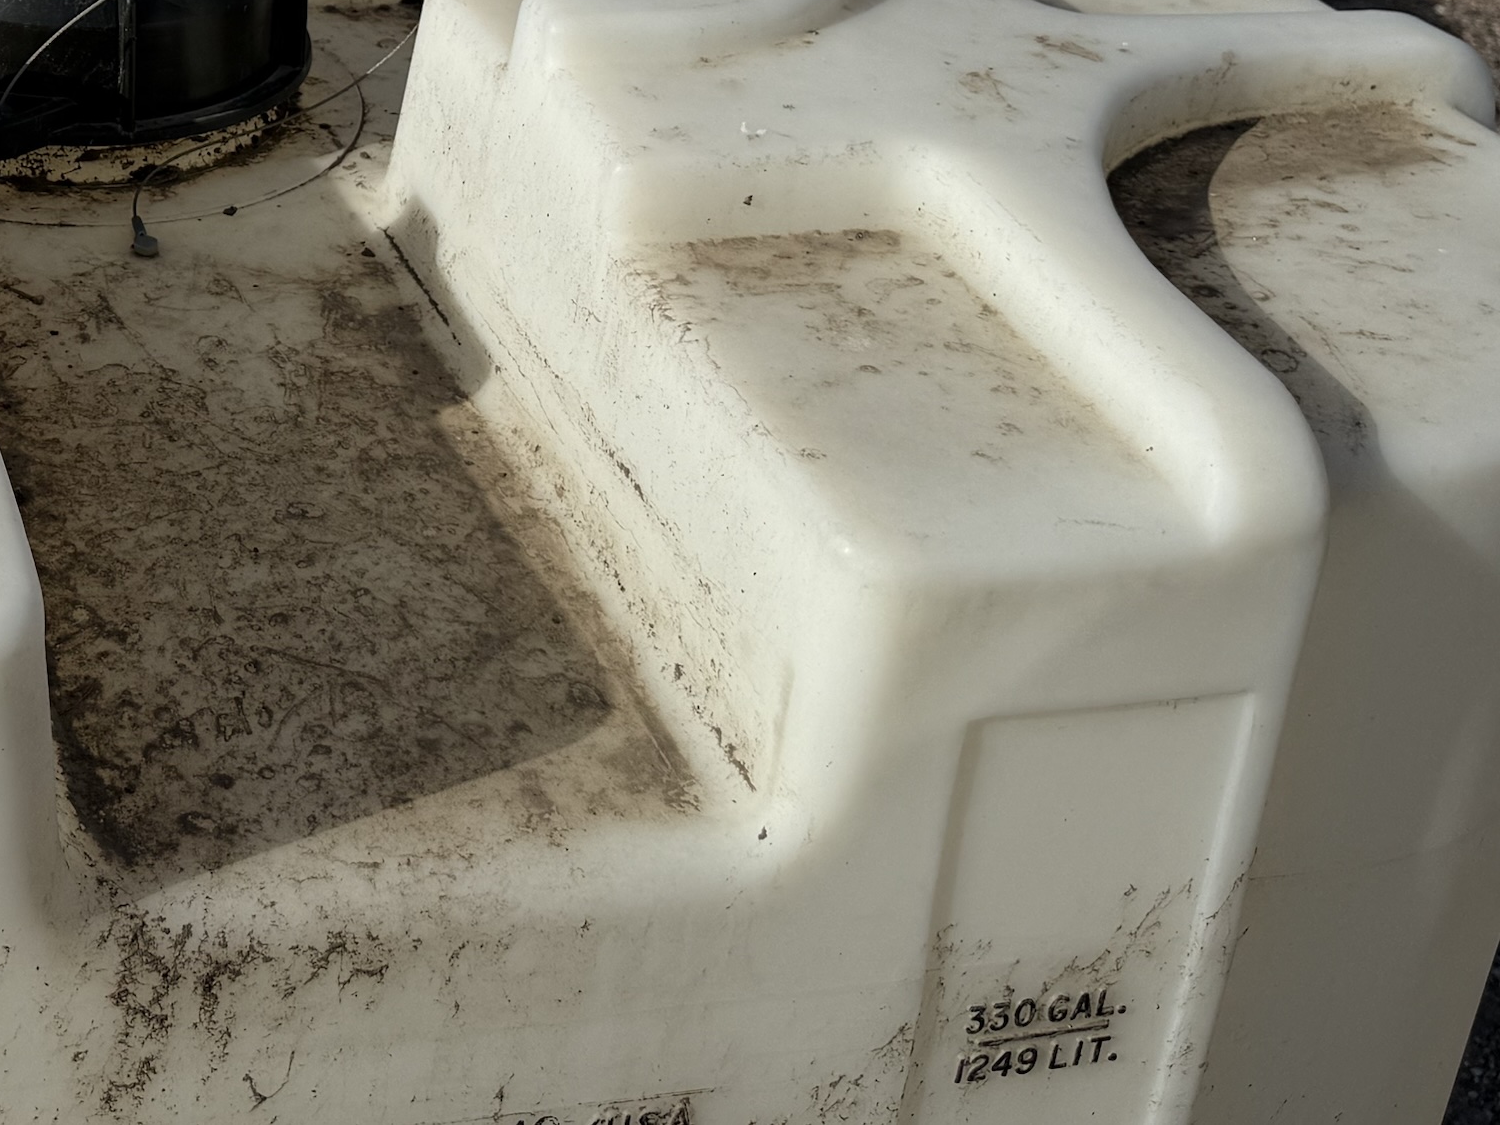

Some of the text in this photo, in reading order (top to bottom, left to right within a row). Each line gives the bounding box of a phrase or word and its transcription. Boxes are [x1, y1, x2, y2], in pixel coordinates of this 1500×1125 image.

[965, 989, 1127, 1035] 330 GAL.
[953, 1035, 1118, 1084] 1249 LIT.
